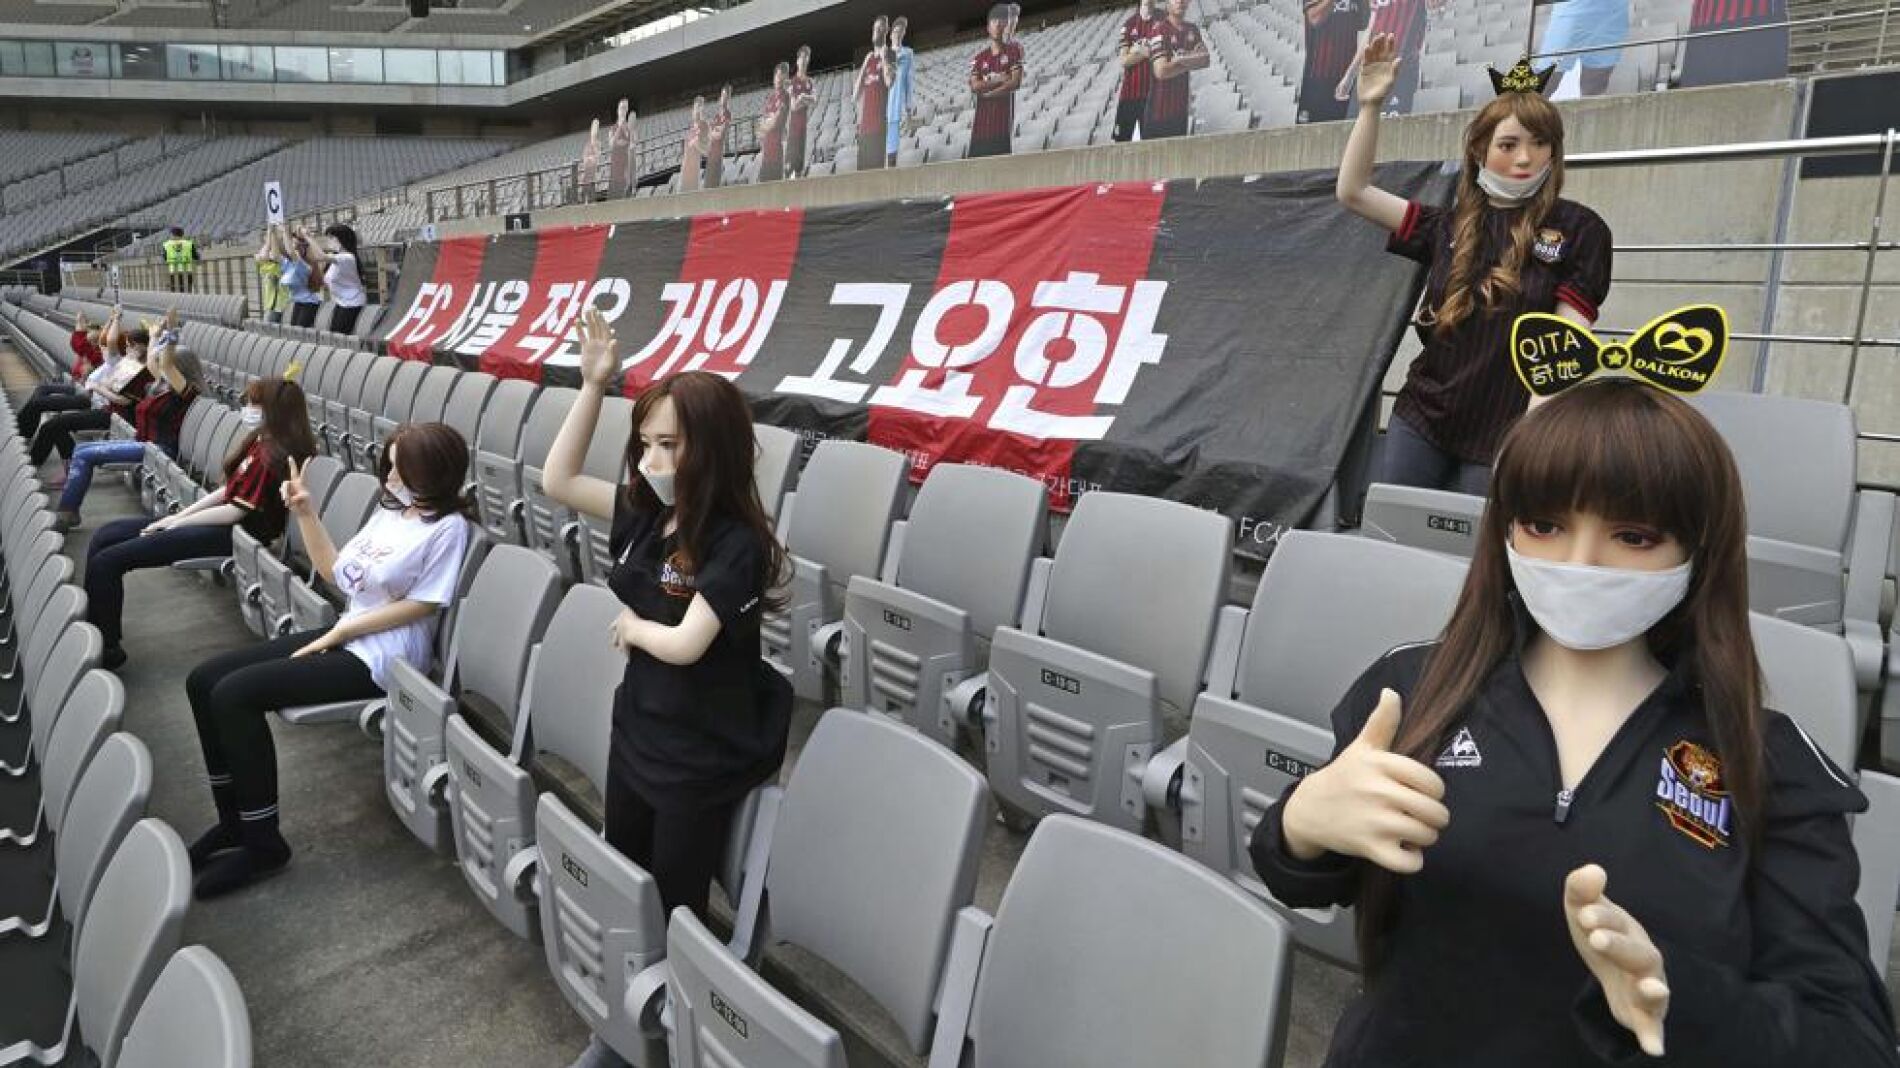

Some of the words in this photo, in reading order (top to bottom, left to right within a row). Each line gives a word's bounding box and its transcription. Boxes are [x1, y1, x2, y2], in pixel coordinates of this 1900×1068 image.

[267, 188, 280, 214] C
[384, 282, 453, 345] FC
[431, 280, 531, 356] 서울
[516, 278, 632, 368] 작은
[620, 278, 788, 381] 거인
[774, 271, 1169, 441] 고요한
[1520, 329, 1581, 363] QITA
[1634, 358, 1707, 383] DALKOM
[1657, 757, 1730, 837] Seoul
